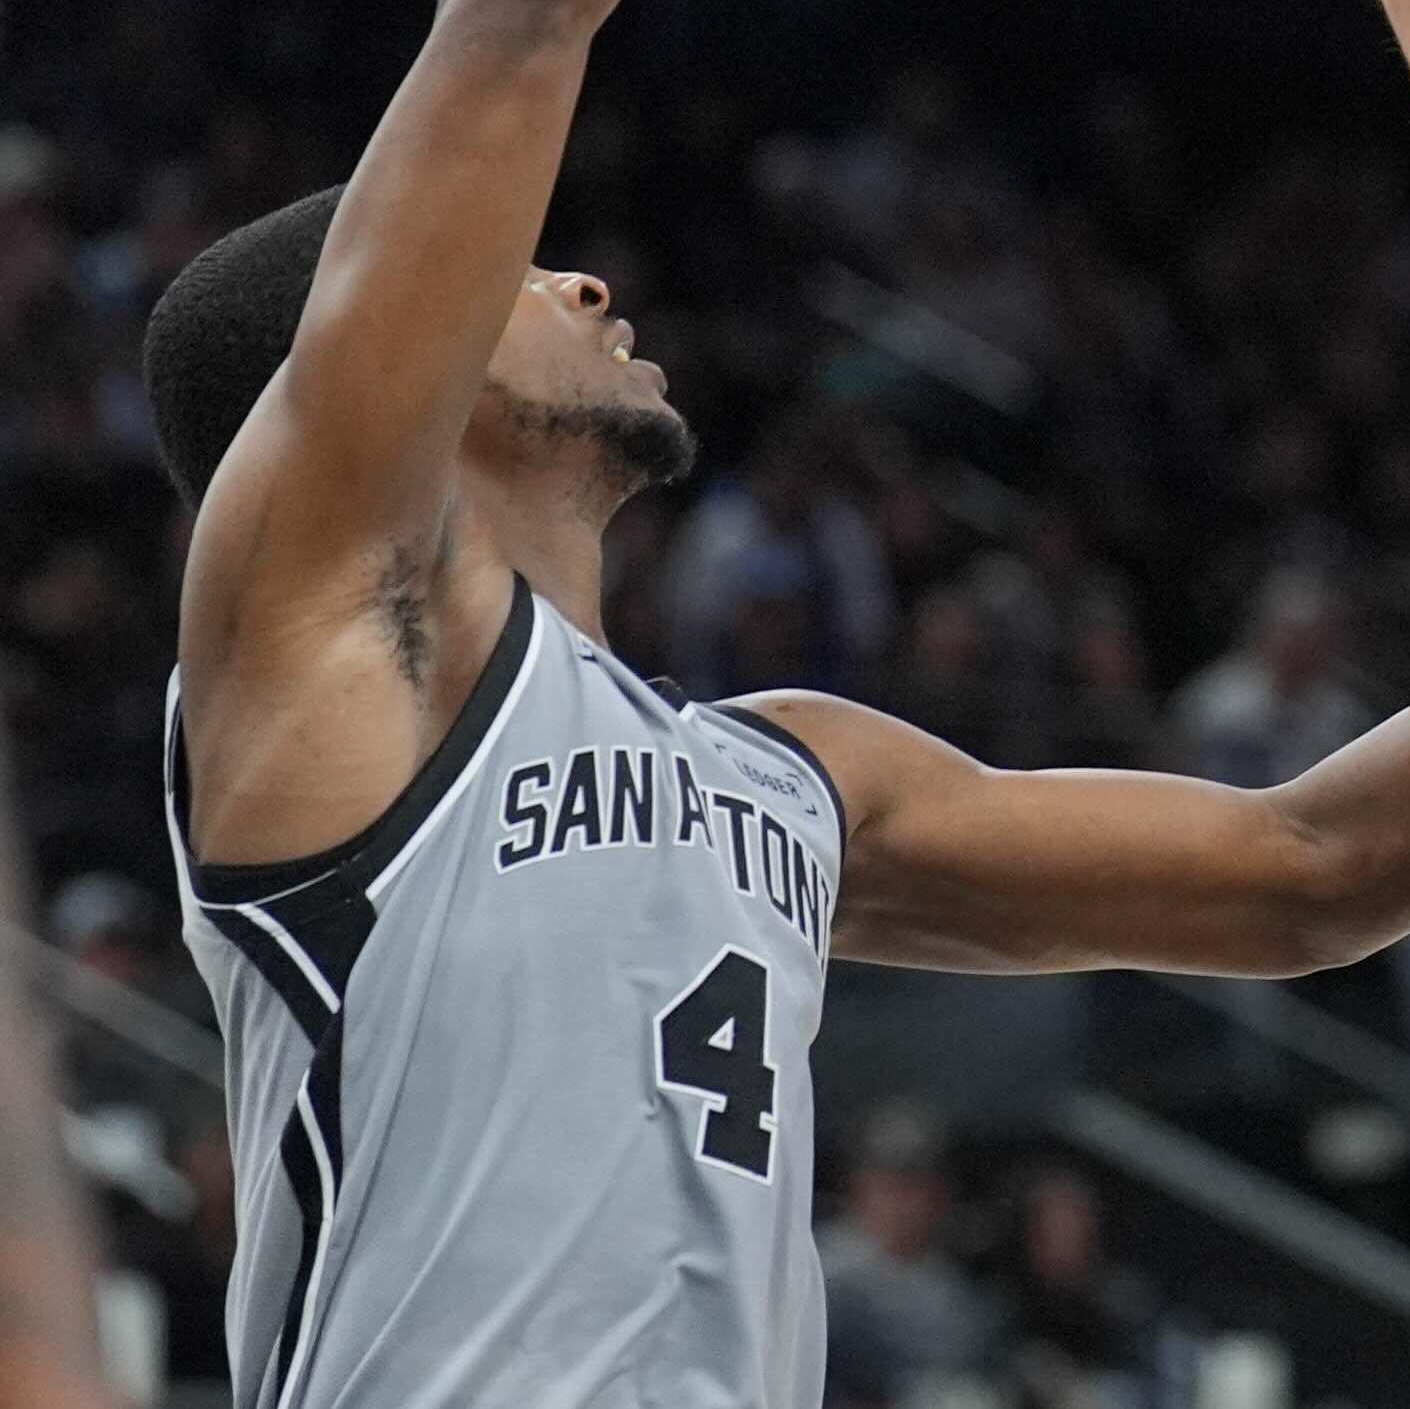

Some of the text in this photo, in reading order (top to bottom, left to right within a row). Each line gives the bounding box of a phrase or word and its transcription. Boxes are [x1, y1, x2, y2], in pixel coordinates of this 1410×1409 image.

[494, 744, 832, 976] SAN ATON
[652, 943, 779, 1185] 4
